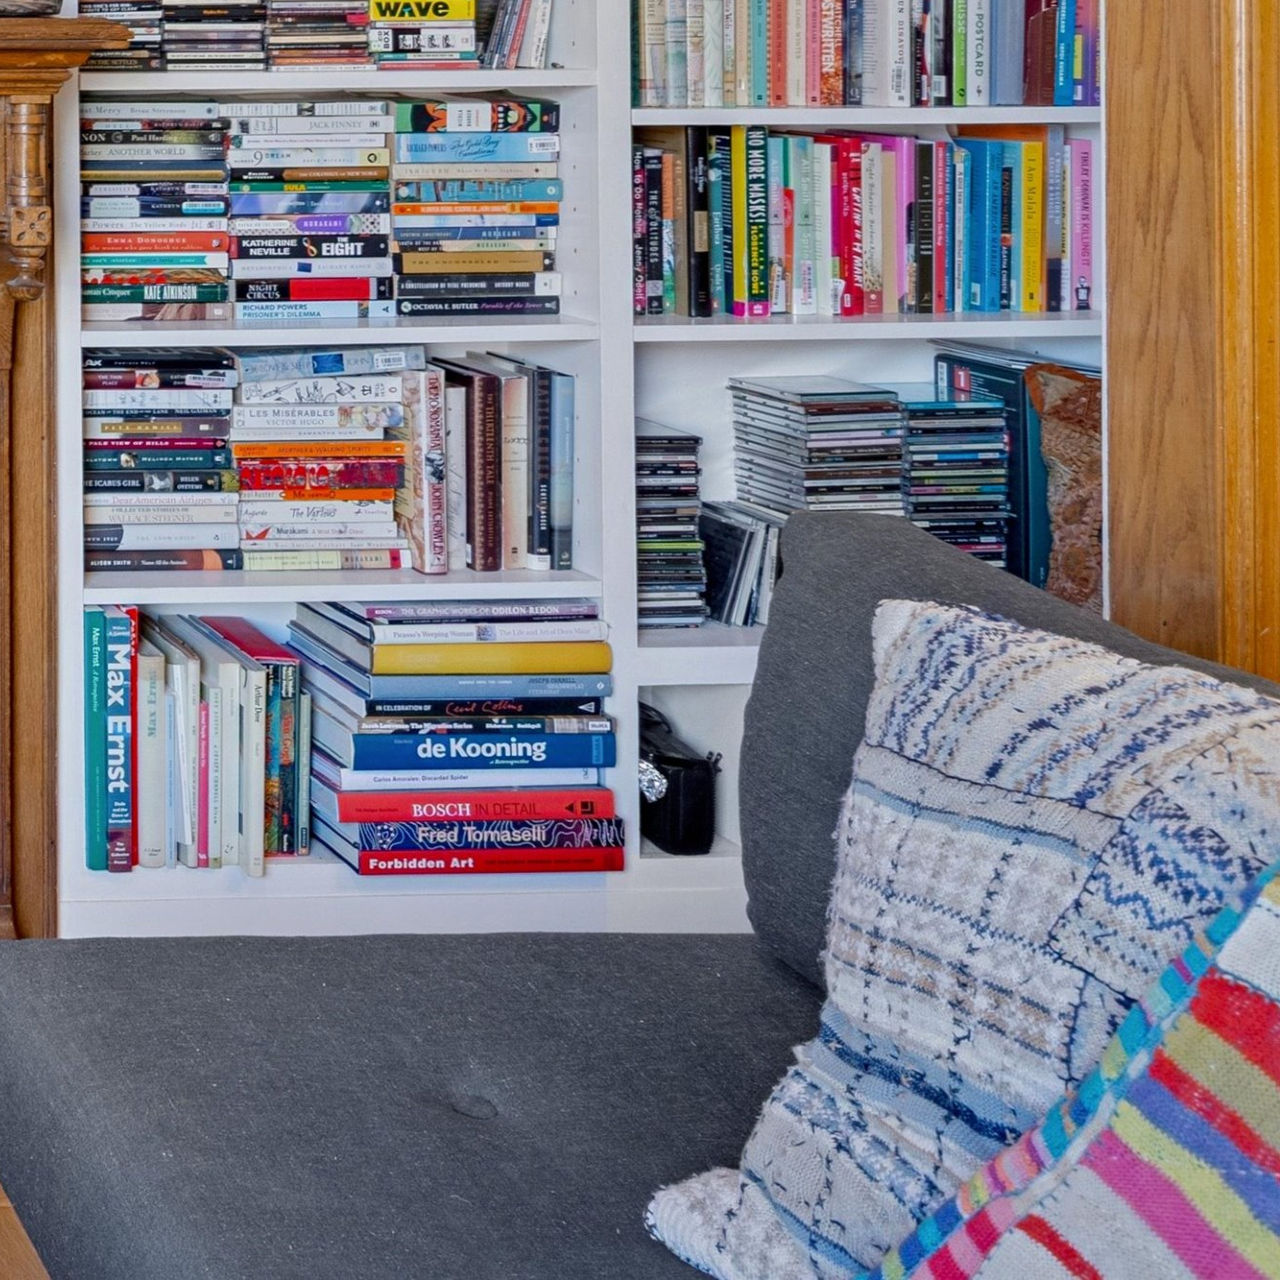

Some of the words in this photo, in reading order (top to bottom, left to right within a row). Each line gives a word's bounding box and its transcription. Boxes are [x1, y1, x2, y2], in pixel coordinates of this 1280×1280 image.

[975, 15, 984, 77] POSTCARD
[308, 121, 329, 130] JACK
[331, 121, 361, 129] FINNEY
[748, 130, 765, 147] NO
[748, 151, 765, 180] MORE
[749, 186, 766, 224] MASKS!
[242, 239, 298, 247] KATHERINE
[322, 242, 365, 256] EIGHT
[249, 247, 290, 256] NEVILLE
[143, 285, 161, 299] KATE
[163, 285, 197, 299] ATKINSON
[246, 291, 281, 299] CIRCUS
[248, 284, 279, 292] NIGHT
[249, 409, 269, 418] LES
[272, 408, 335, 417] MISÉRABLES
[112, 497, 135, 505] Dear
[136, 496, 177, 504] American
[401, 608, 415, 616] THE
[492, 606, 526, 615] ODILON
[528, 606, 559, 614] REDON
[92, 627, 100, 644] Max
[92, 645, 100, 668] Ernst
[107, 644, 131, 708] Max
[254, 683, 262, 705] Arthur
[255, 706, 263, 723] Dove
[384, 704, 422, 712] CELEBRATION
[445, 700, 475, 715] Cecil
[481, 699, 523, 715] Collins
[107, 716, 131, 793] Ernst
[417, 741, 447, 758] de
[450, 738, 547, 761] Kooning
[412, 803, 471, 817] BOSCH
[475, 804, 489, 815] IN
[492, 803, 540, 815] DETAIL
[417, 827, 459, 843] Fred
[462, 825, 546, 843] Tomaselli
[369, 858, 444, 869] Forbidden
[450, 858, 474, 868] Art
